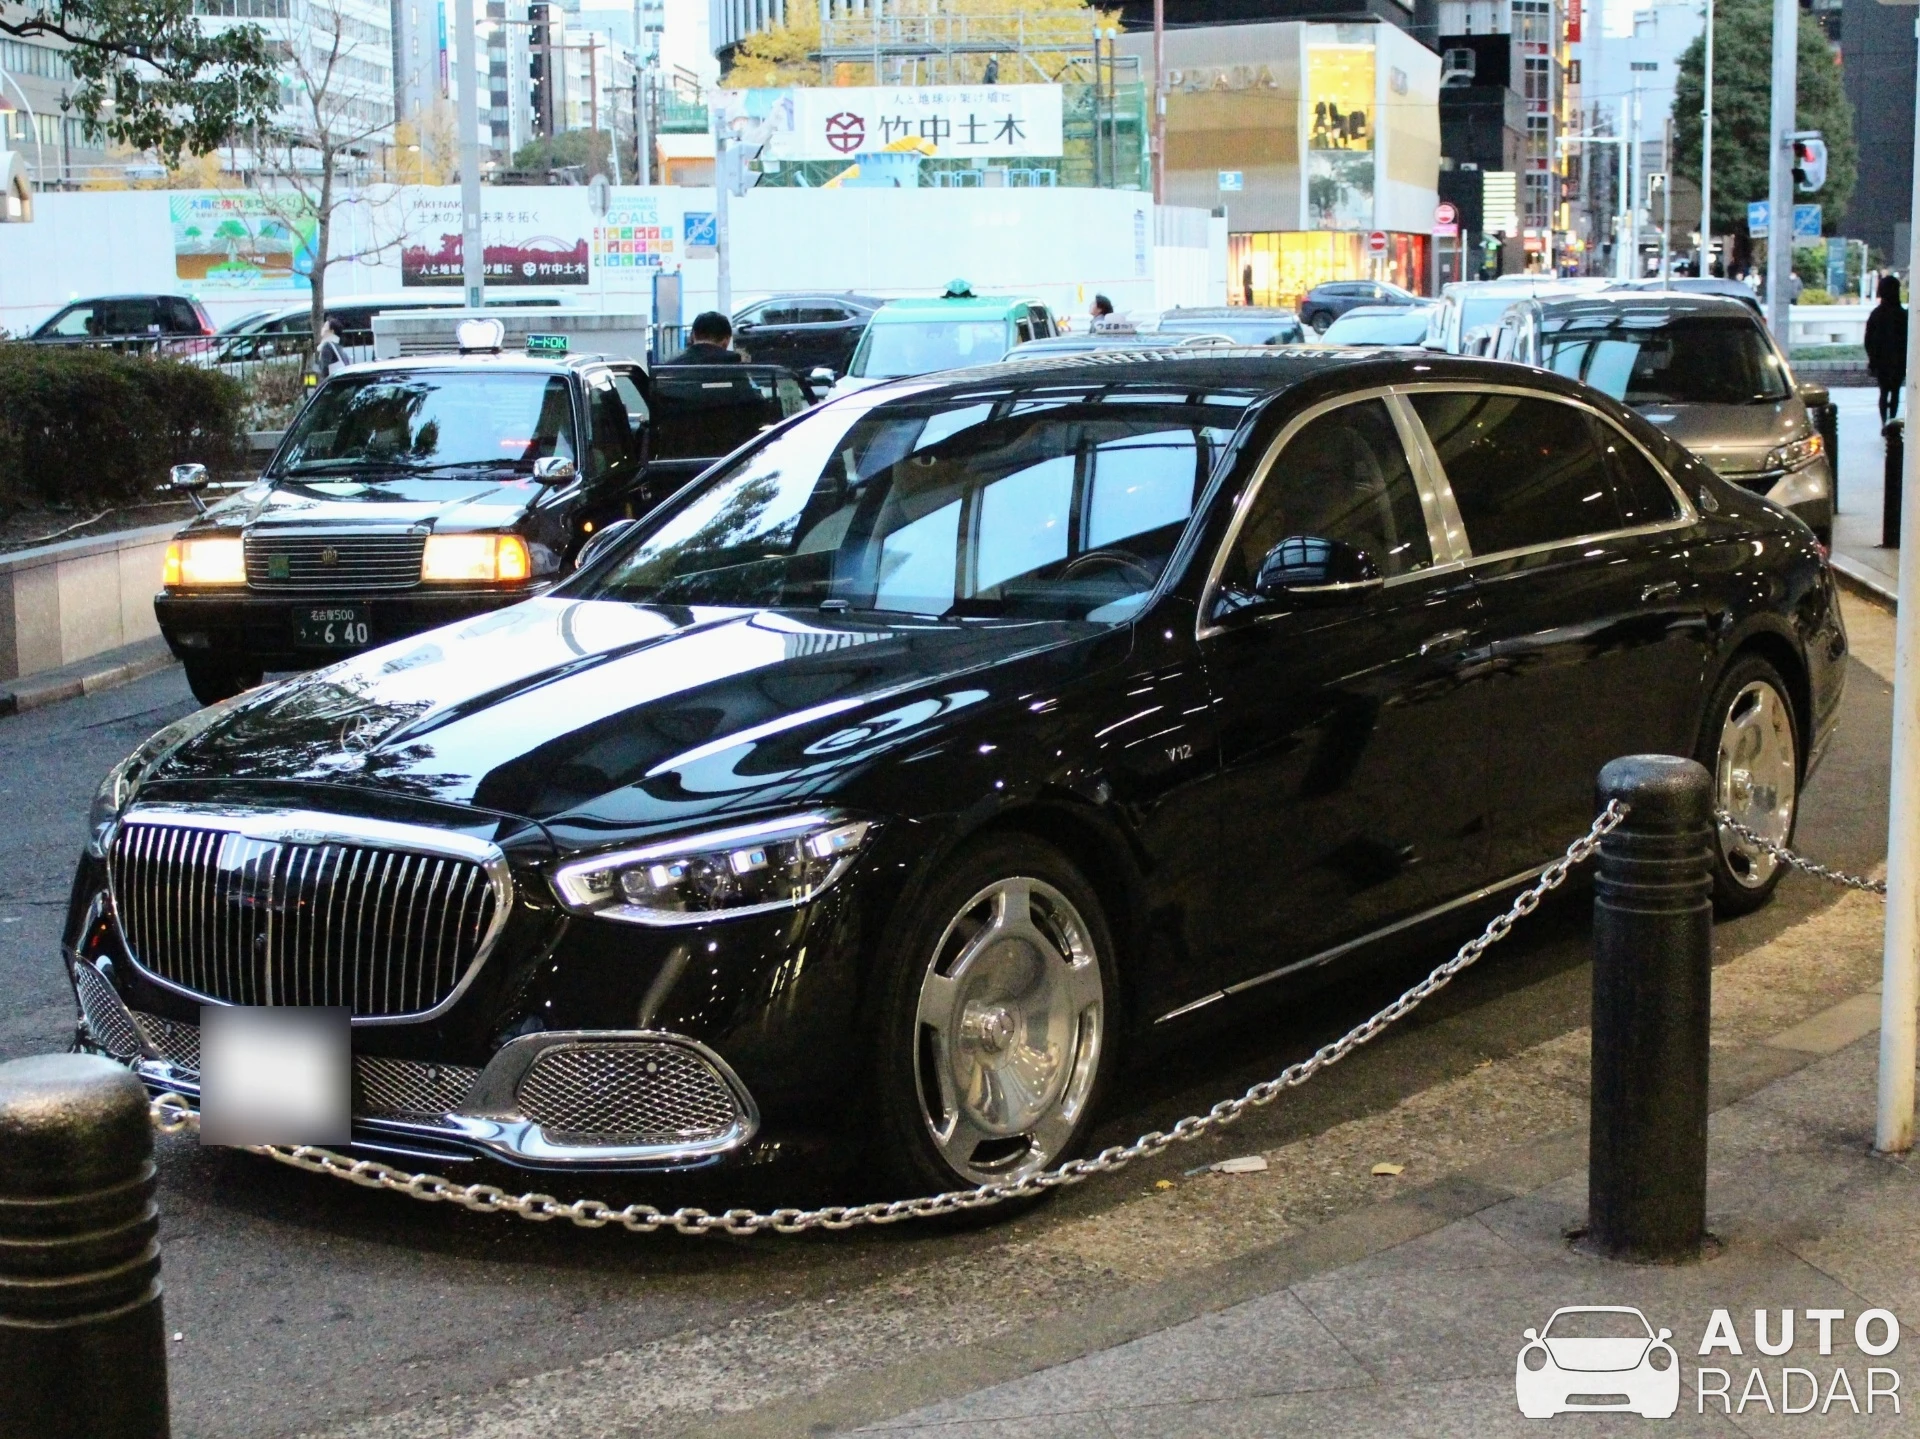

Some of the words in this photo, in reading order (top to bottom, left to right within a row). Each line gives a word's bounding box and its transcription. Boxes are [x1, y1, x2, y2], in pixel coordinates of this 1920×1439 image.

[877, 113, 1026, 147] 竹中土木
[607, 212, 659, 225] GOALS
[538, 263, 586, 275] 竹中土木
[527, 336, 566, 349] カードOK
[1165, 744, 1193, 761] V12
